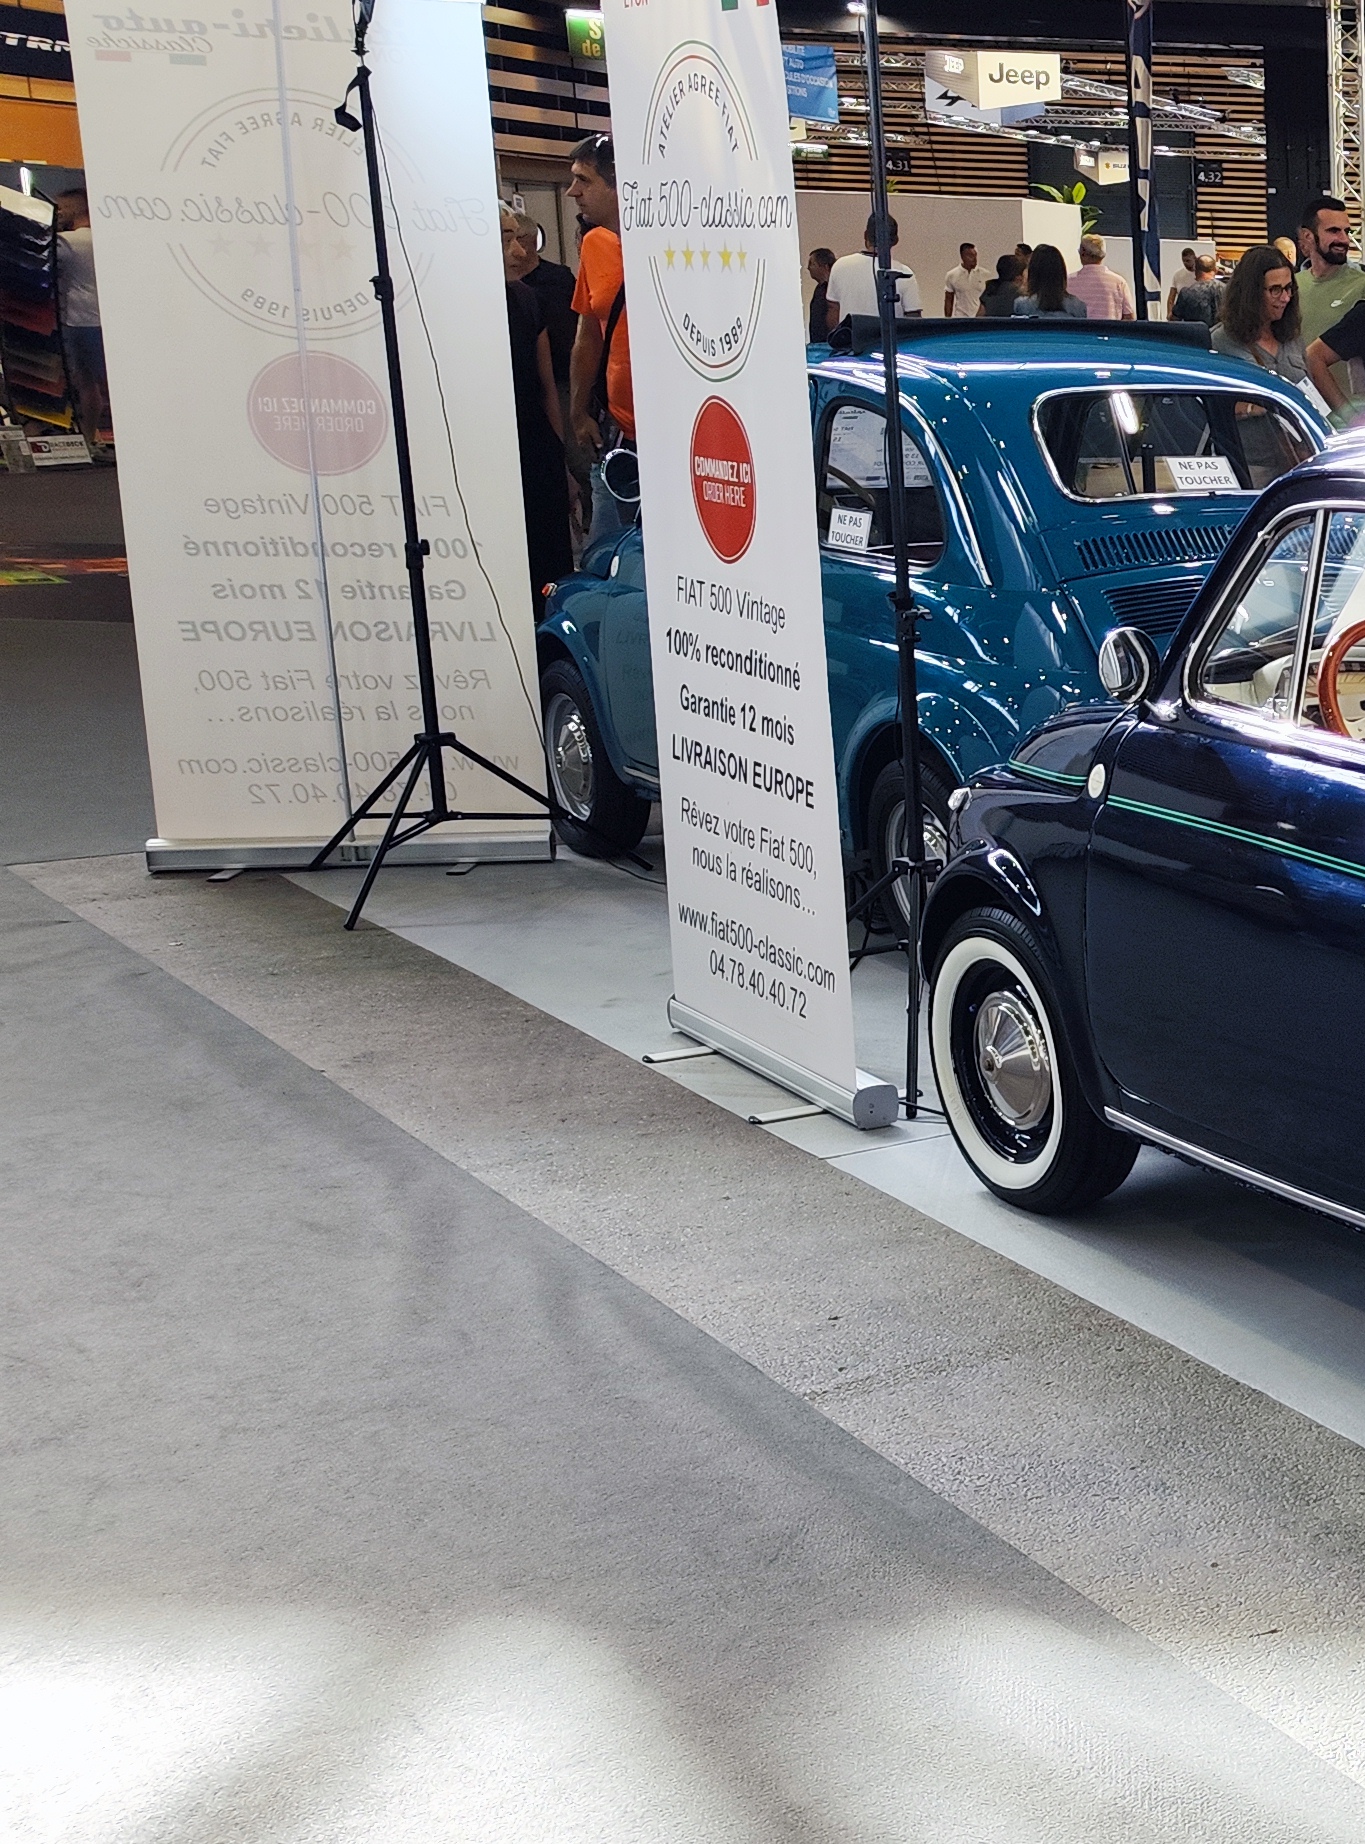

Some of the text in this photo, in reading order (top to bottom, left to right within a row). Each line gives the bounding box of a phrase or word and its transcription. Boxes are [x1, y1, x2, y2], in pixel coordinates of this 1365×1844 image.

[988, 62, 1050, 89] Jeep
[657, 72, 741, 159] ATELIER AGREE FIAT
[886, 159, 911, 171] 4.31
[1197, 171, 1222, 183] 4.32
[622, 178, 793, 232] Fiat 500-classic.com
[682, 312, 744, 358] DEPUIS 1989
[694, 455, 751, 484] COMMANDEZ ICI
[1177, 474, 1233, 487] TOUCHER
[1178, 460, 1220, 472] NE PAS
[702, 480, 746, 508] ORDER HERE
[831, 530, 864, 547] TOUCHER
[837, 513, 863, 529] NE PAS
[676, 574, 786, 634] FIAT 500 Vintage
[665, 627, 801, 691] 100% reconditionné
[680, 684, 795, 746] Garantie 12 mois
[671, 733, 815, 809] LIVRAISON EUROPE
[680, 796, 818, 880] Rêvez votre Fiat 500,
[691, 845, 723, 876] nous
[726, 851, 737, 882] la
[678, 902, 836, 994] www.fiat500-classic.com
[709, 949, 807, 1019] 04.78.40.40.72
